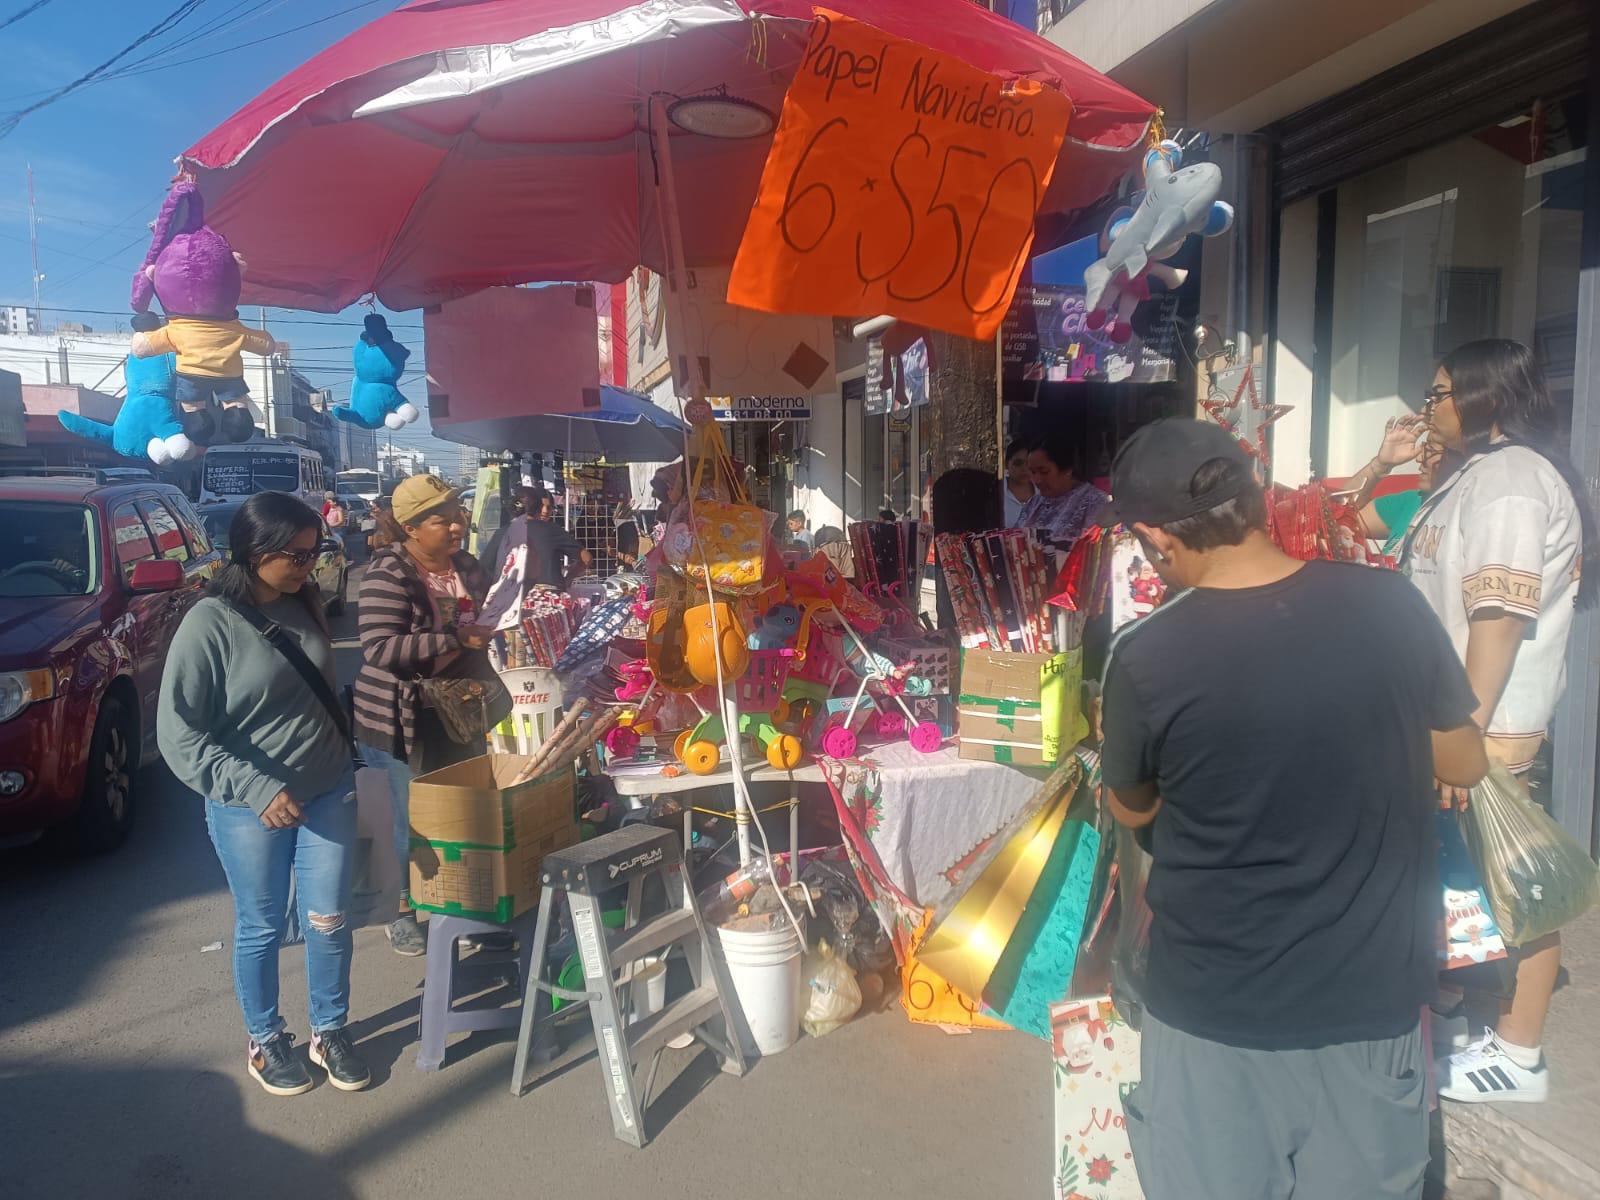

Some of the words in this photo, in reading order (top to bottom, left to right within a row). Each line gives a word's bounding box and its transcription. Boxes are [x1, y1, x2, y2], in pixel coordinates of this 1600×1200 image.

[803, 15, 888, 102] Papel
[776, 117, 848, 252] 6
[738, 395, 804, 409] moderna
[512, 692, 550, 705] TECATE
[619, 847, 662, 871] CUPRUM
[908, 961, 934, 1010] 6
